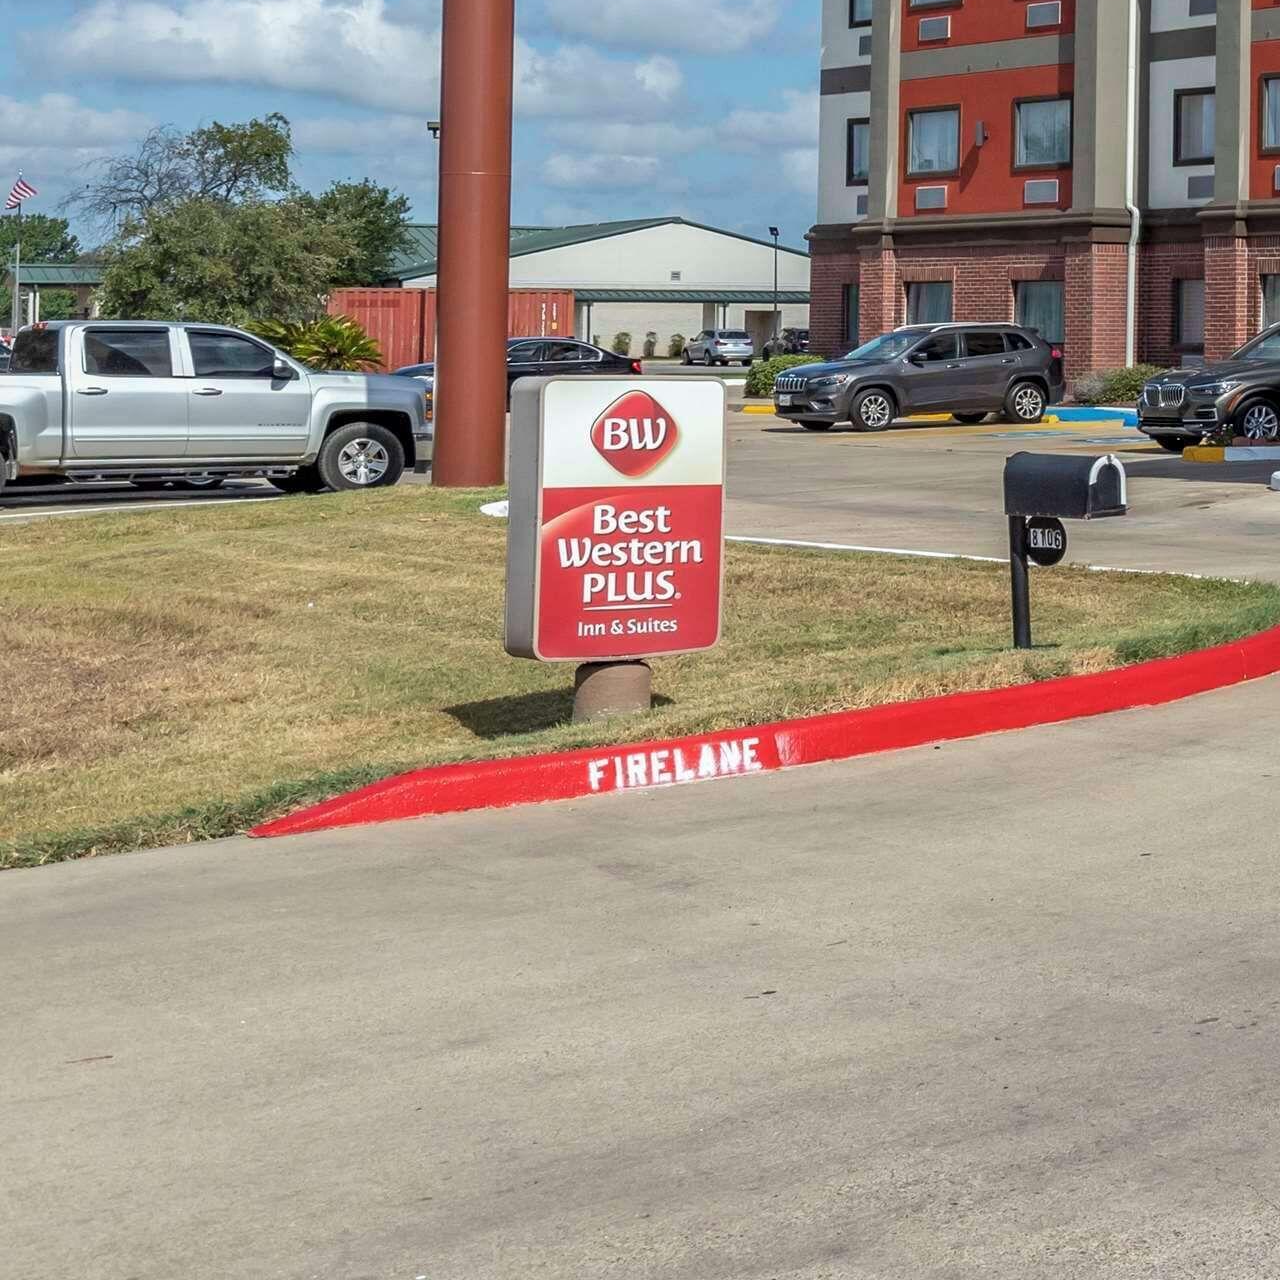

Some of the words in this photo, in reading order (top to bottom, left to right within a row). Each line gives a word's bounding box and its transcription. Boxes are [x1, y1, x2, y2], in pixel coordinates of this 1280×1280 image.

[602, 417, 667, 451] BW
[593, 504, 671, 535] Best
[557, 537, 703, 568] Western
[1032, 529, 1061, 548] 8106
[577, 621, 606, 637] Inn
[610, 620, 624, 635] &
[627, 618, 678, 634] Suites
